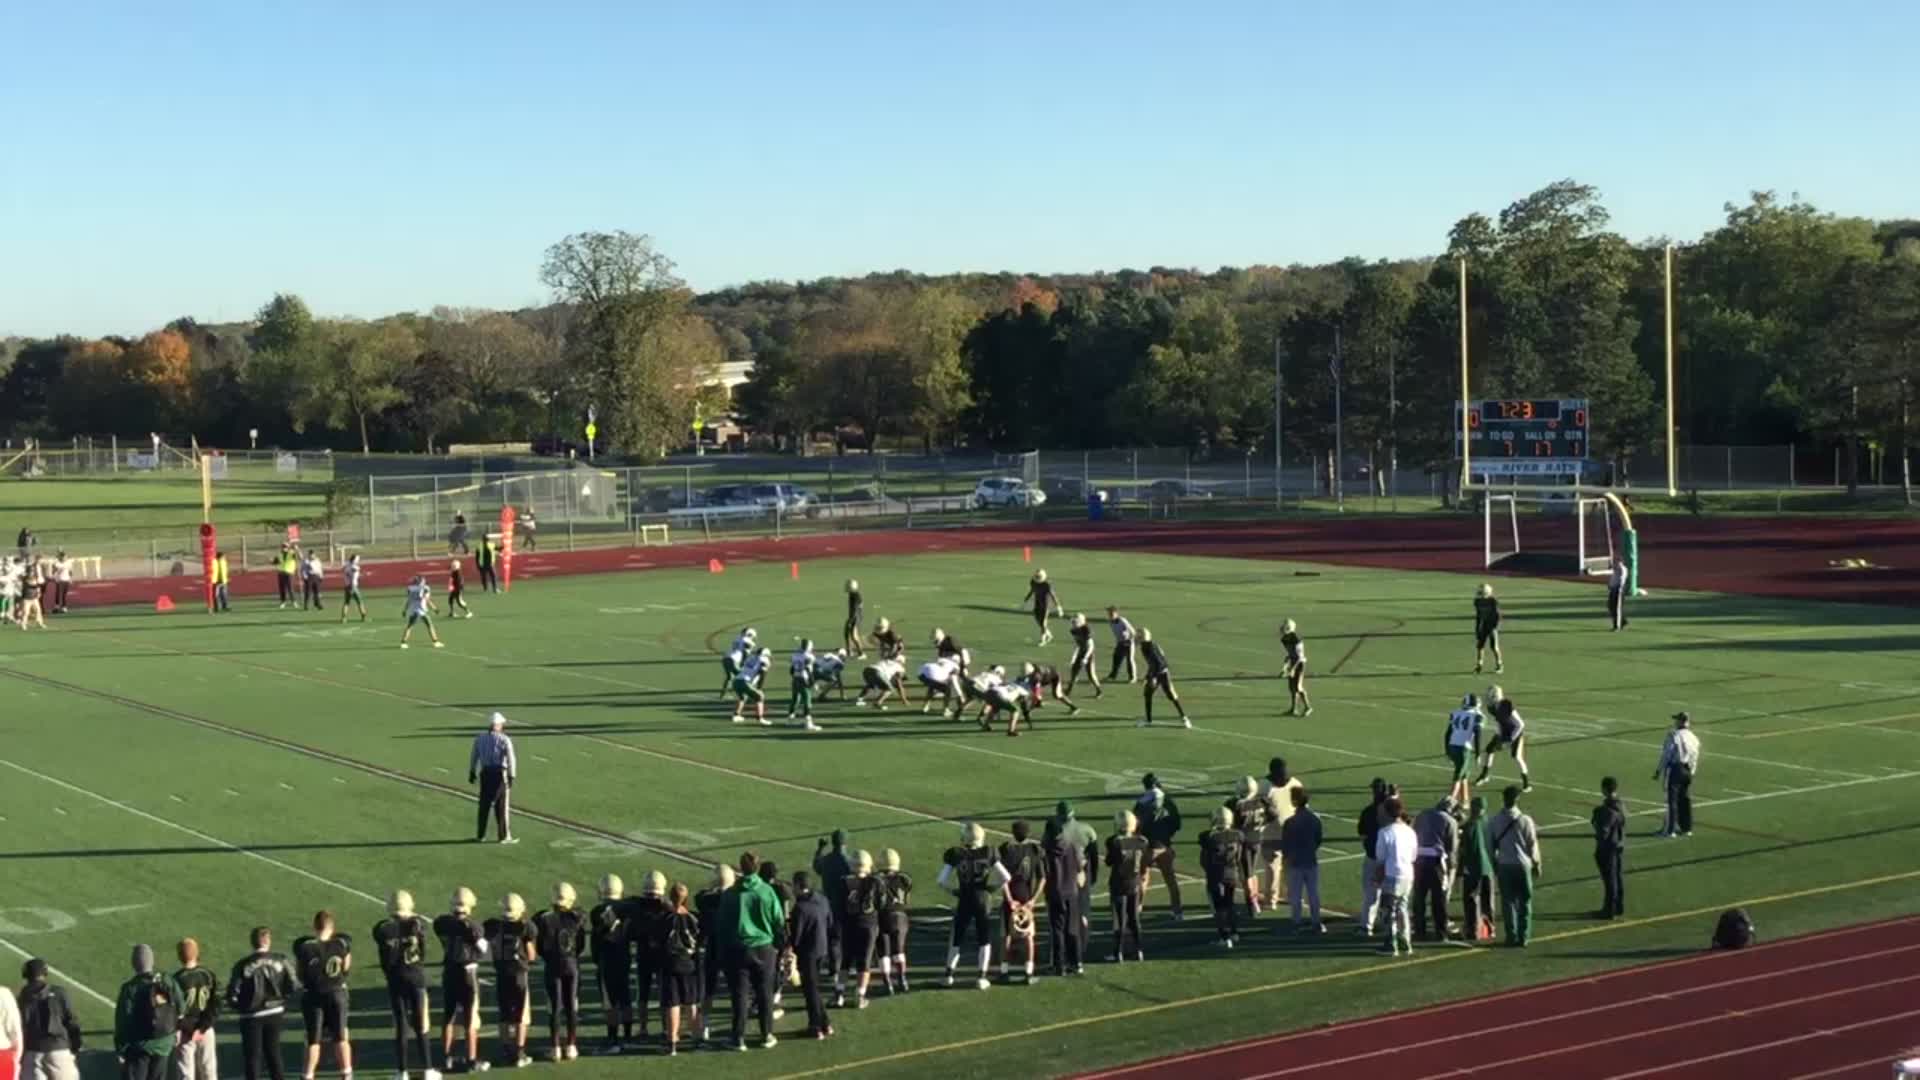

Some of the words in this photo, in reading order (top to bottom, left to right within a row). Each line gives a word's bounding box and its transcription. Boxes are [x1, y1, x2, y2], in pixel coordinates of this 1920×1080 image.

[1501, 463, 1539, 472] RIVER
[1545, 463, 1577, 472] RATS
[1453, 715, 1470, 731] 44
